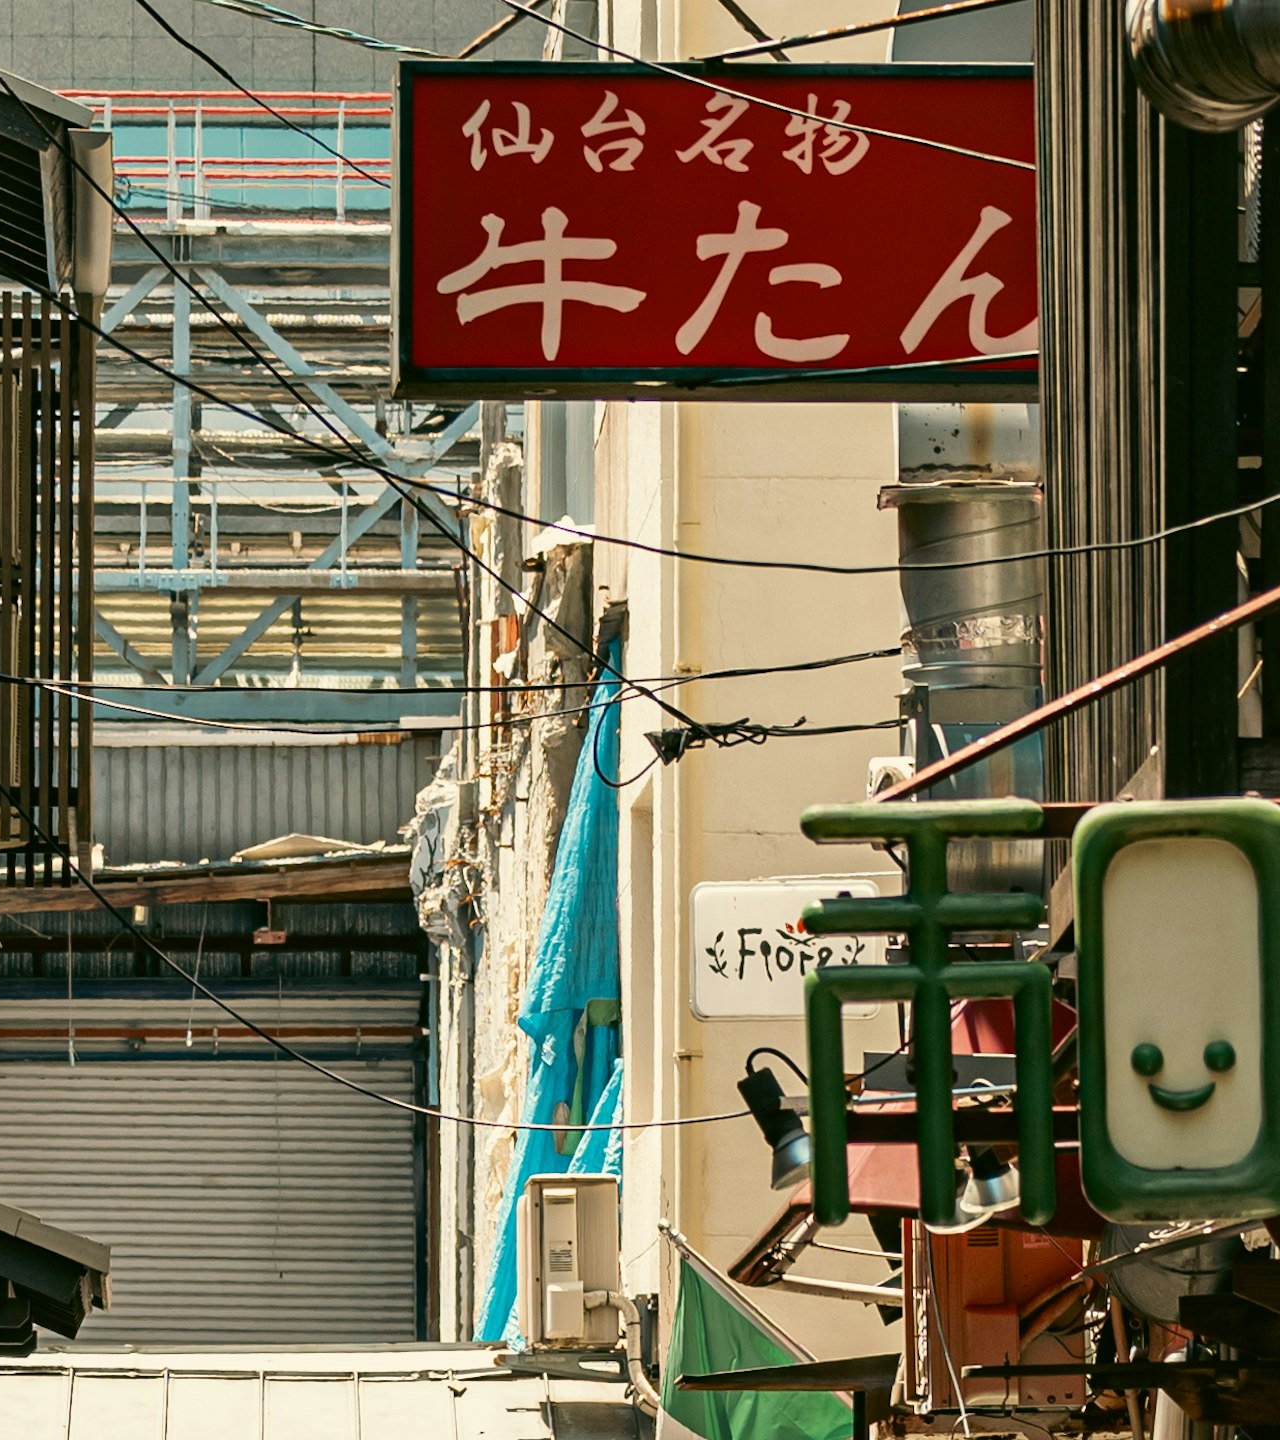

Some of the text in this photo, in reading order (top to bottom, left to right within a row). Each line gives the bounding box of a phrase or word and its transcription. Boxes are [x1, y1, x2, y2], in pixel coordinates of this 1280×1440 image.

[462, 89, 871, 177] 仙台名物
[436, 200, 1040, 363] 牛たん
